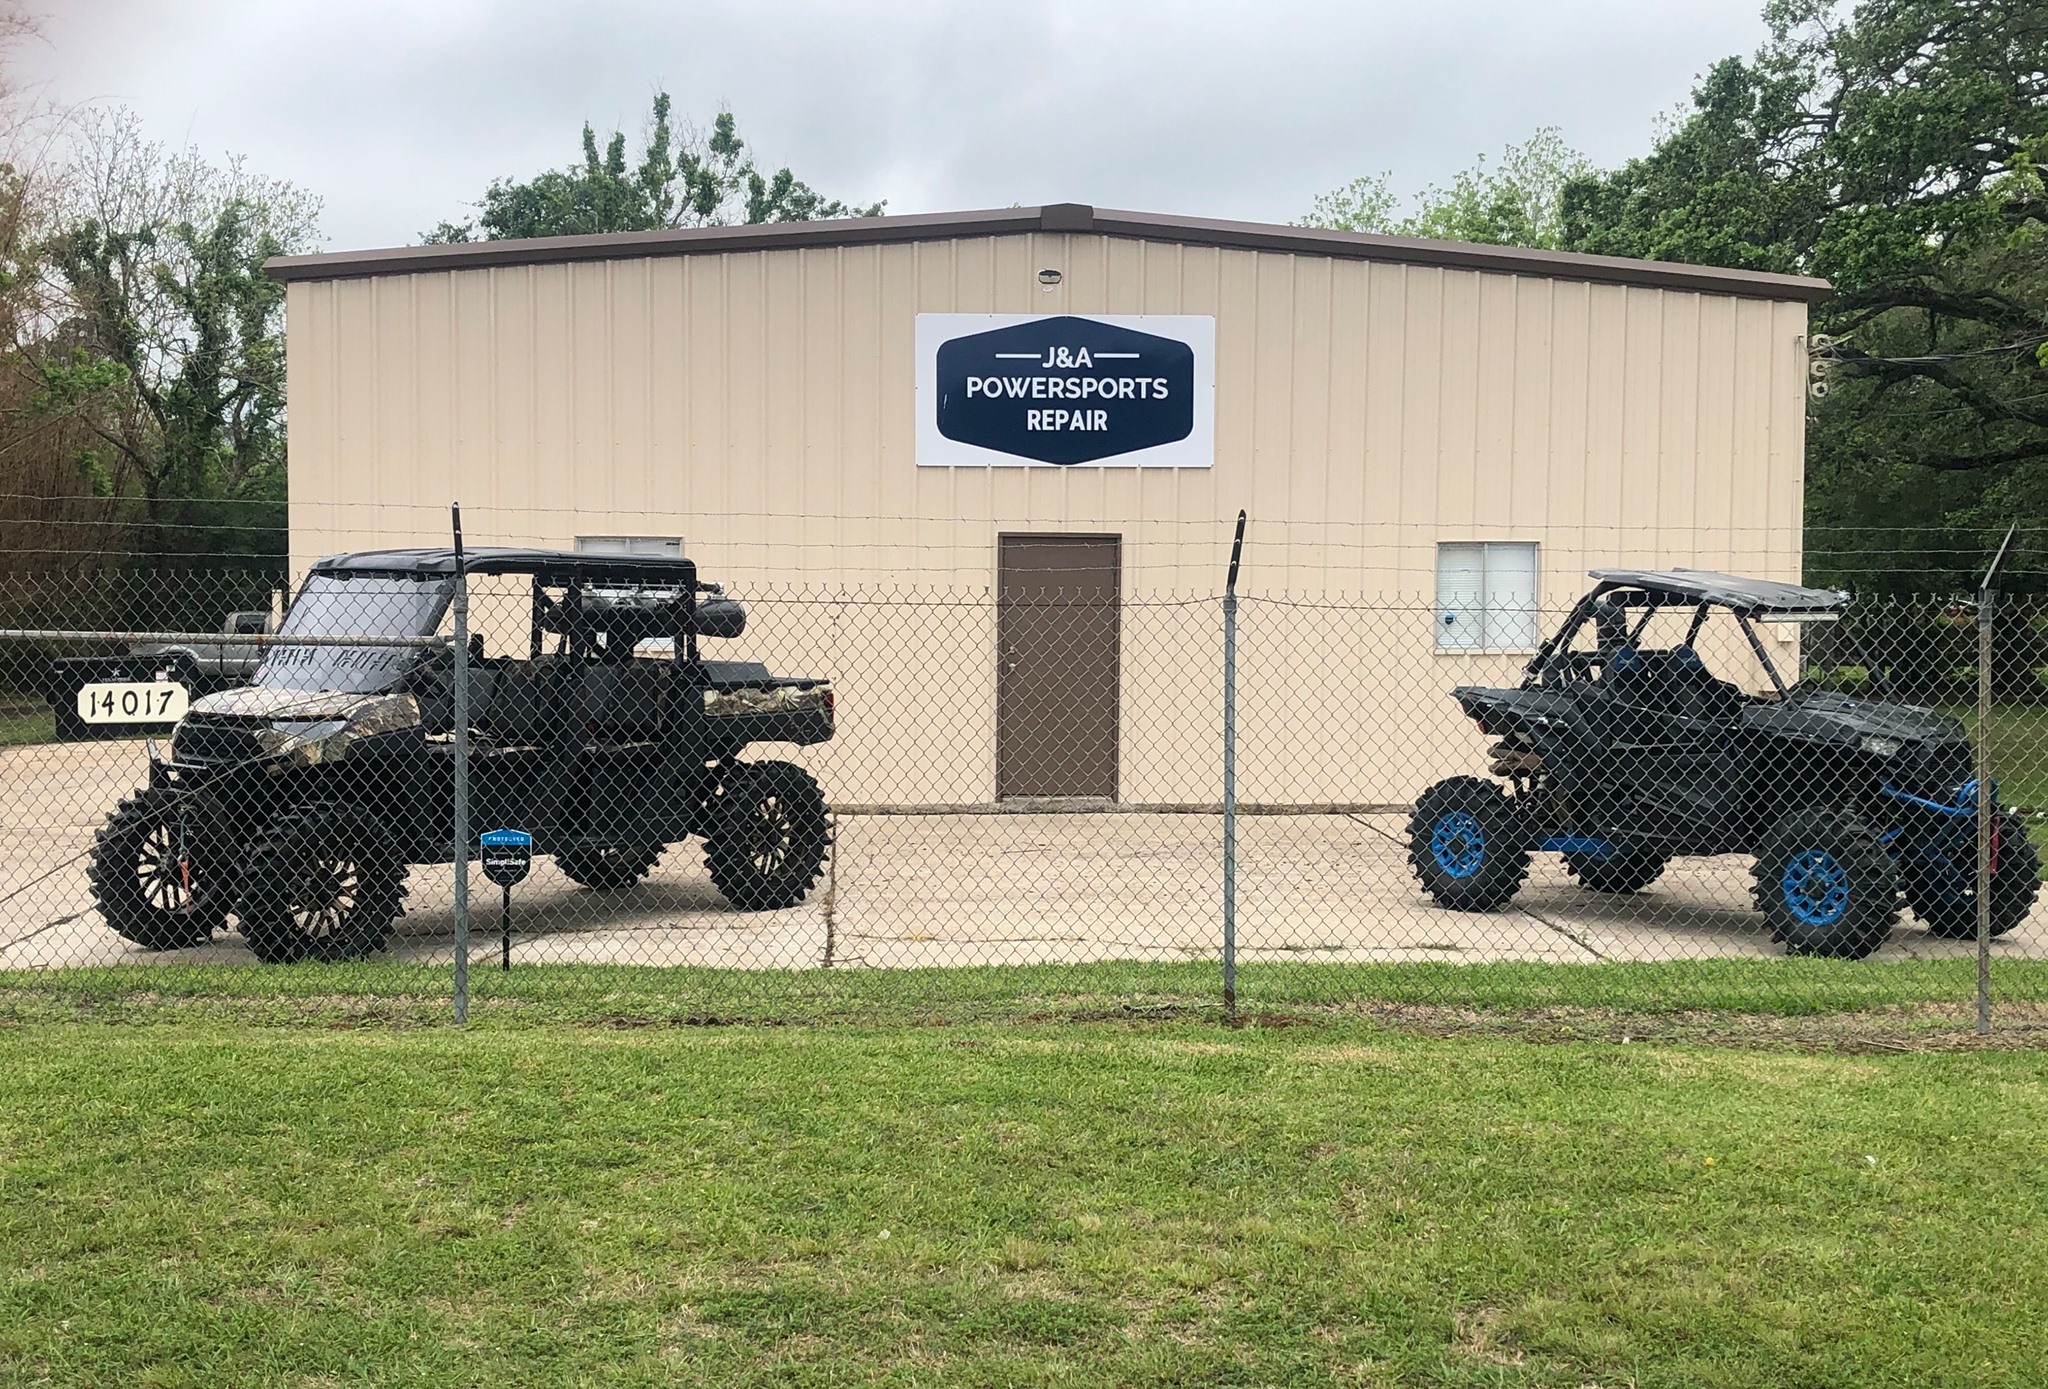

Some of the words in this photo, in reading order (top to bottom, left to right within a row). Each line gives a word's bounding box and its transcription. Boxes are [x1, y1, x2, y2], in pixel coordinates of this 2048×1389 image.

[1042, 346, 1093, 369] J&A
[966, 376, 1169, 399] POWERSPORTS
[1027, 409, 1108, 431] REPAIR
[90, 690, 174, 717] 14017
